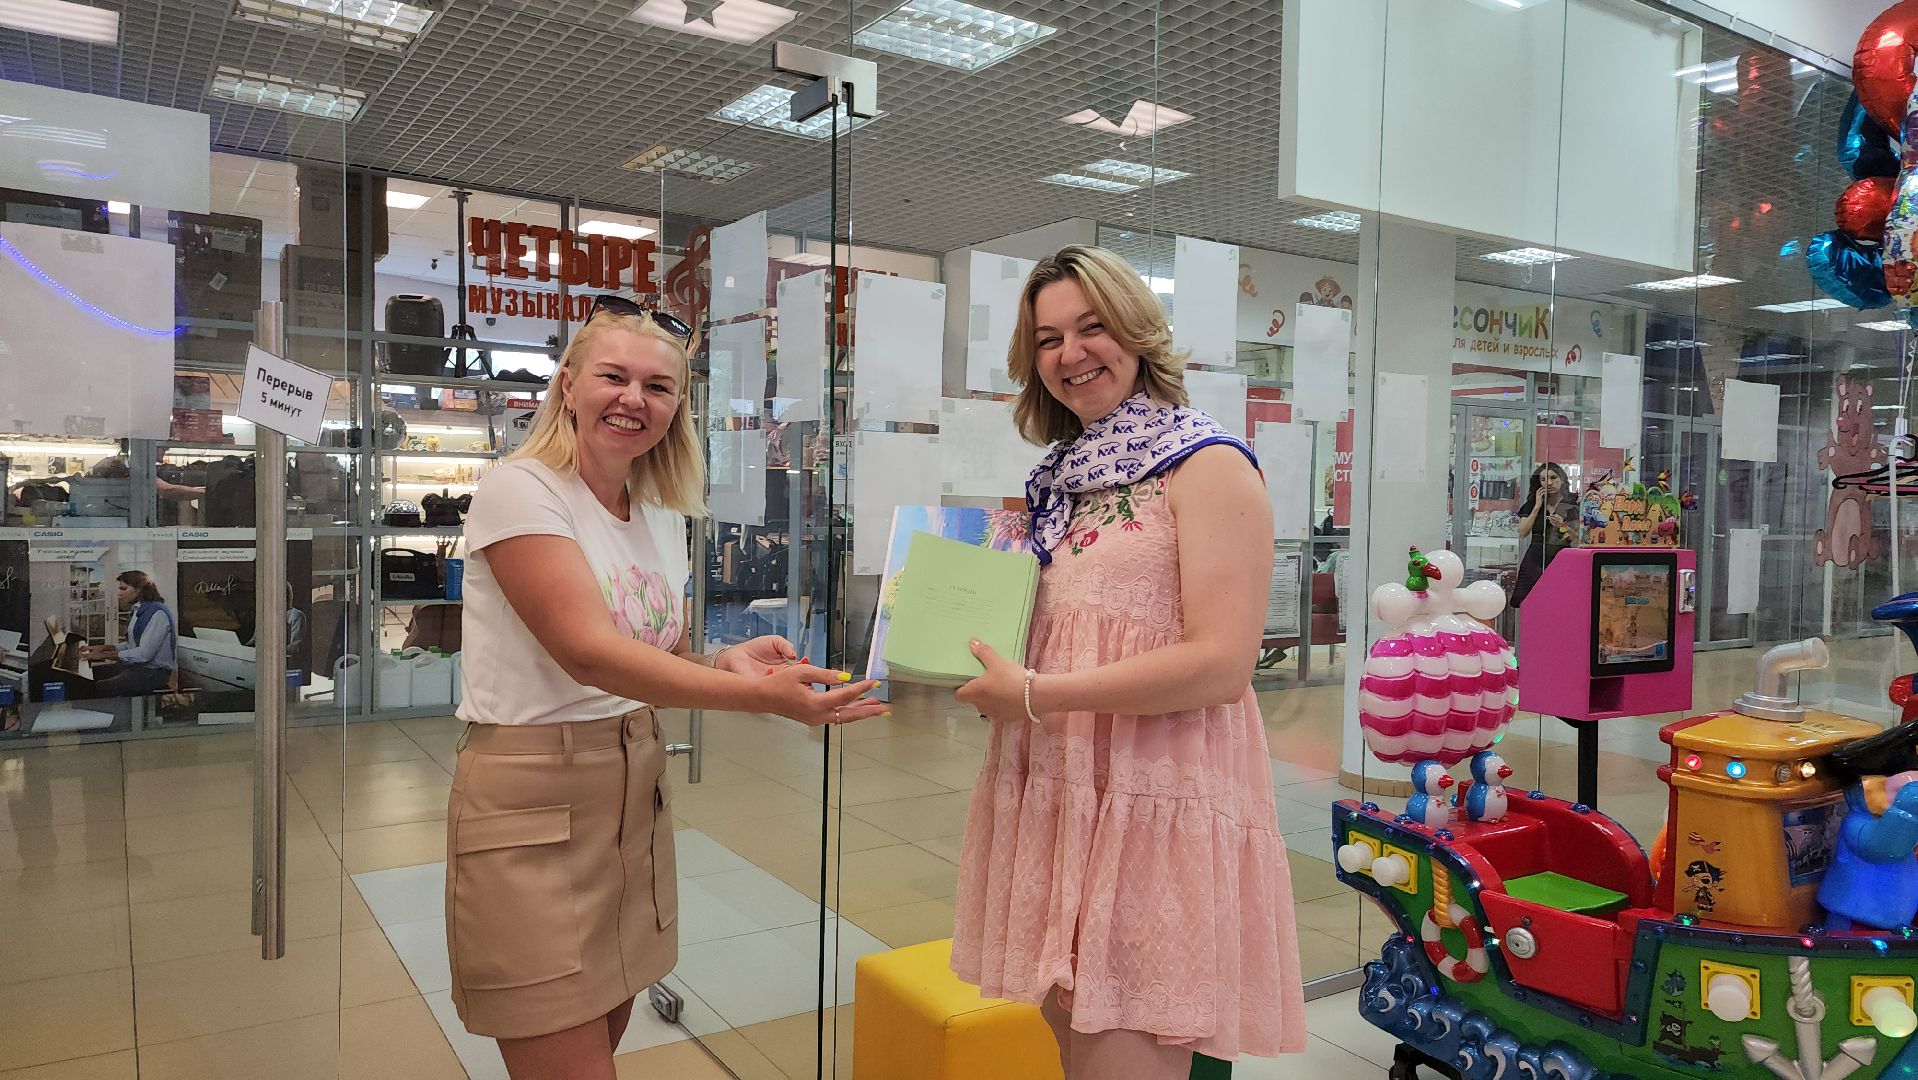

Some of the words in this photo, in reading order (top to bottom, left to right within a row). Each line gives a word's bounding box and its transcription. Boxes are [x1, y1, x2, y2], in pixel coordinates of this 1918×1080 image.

[468, 217, 657, 293] ЧЕТЫРЕ
[468, 285, 657, 323] МУЗЫКАЛ
[1453, 338, 1466, 349] ля
[1470, 337, 1499, 353] детей
[1503, 343, 1510, 352] и
[1513, 345, 1558, 360] взрослых
[257, 367, 313, 400] Перерыв
[261, 392, 268, 403] 5
[269, 398, 303, 418] минут
[513, 400, 541, 409] ВНИМА
[1334, 451, 1353, 465] МУ
[1334, 469, 1353, 482] СТ
[181, 530, 208, 538] CASIO
